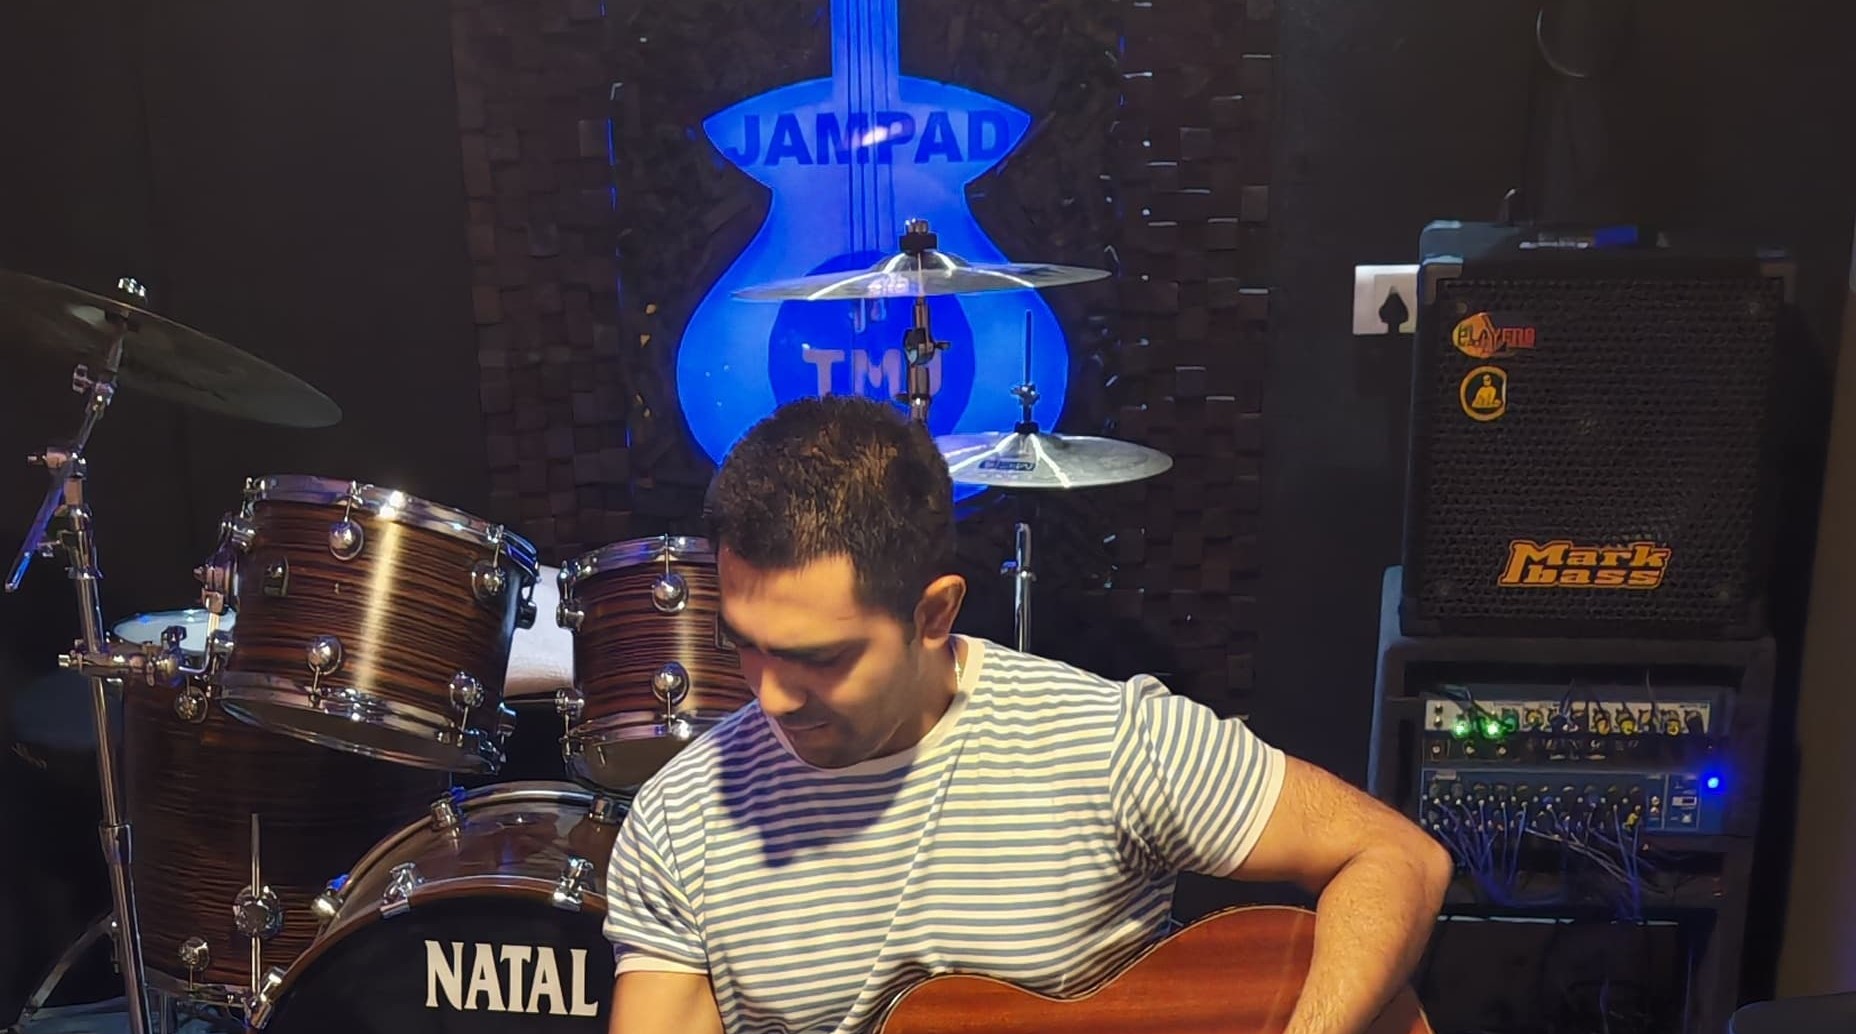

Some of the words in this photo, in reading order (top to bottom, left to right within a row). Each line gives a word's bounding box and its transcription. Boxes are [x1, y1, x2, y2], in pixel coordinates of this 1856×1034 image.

[728, 110, 1010, 166] JAMPAD
[1502, 542, 1669, 583] Mark
[1523, 564, 1661, 586] bass
[425, 940, 599, 1017] NATAL
